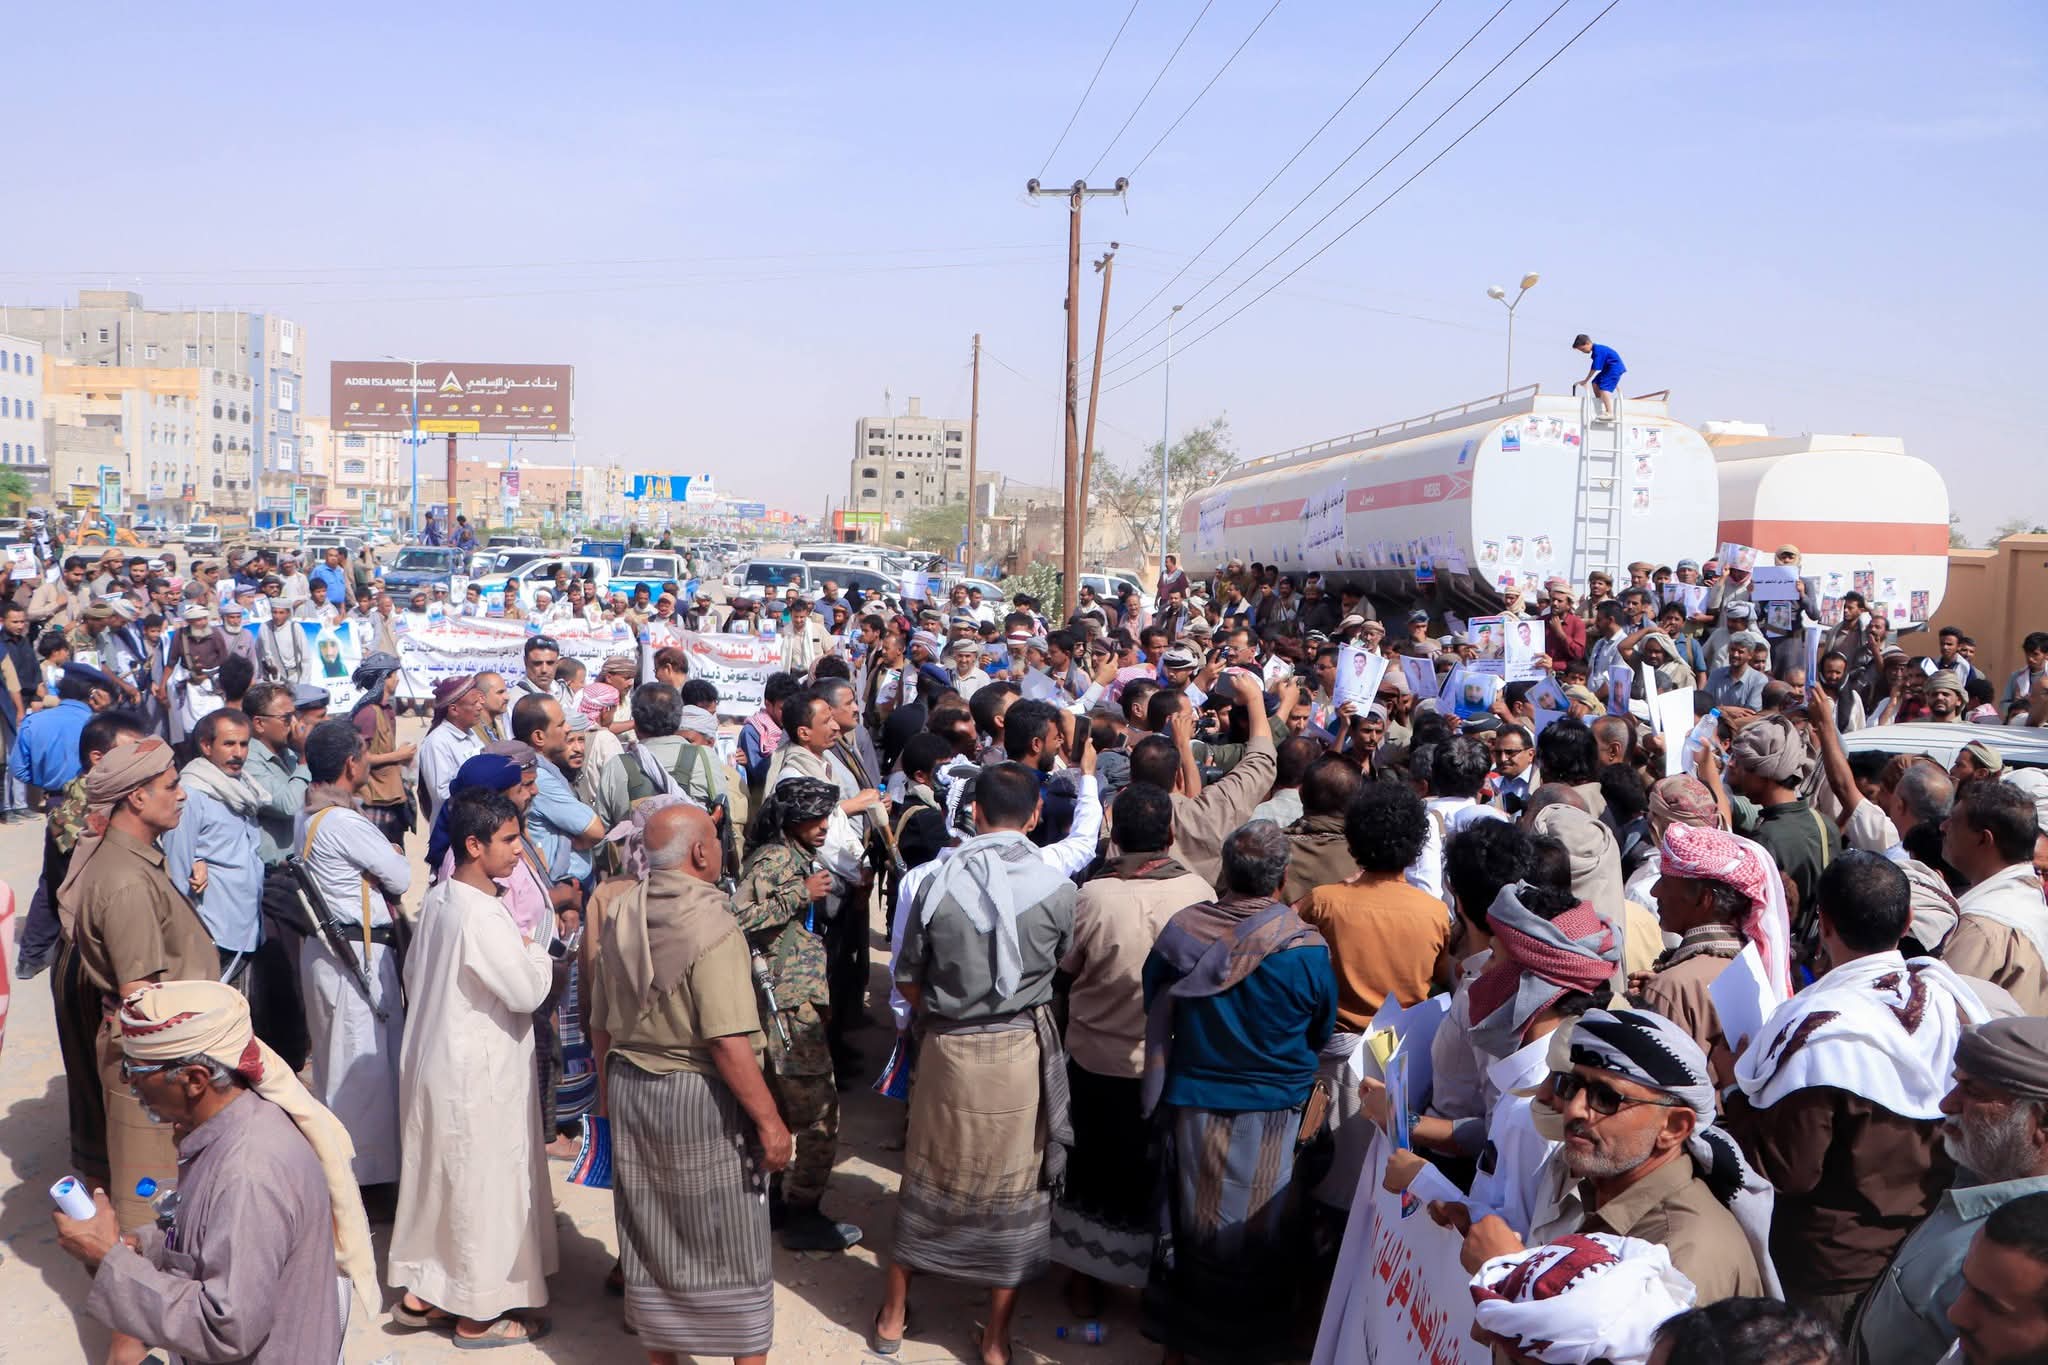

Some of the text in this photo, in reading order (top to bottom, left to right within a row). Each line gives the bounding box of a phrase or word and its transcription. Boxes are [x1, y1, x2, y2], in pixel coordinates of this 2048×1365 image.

[344, 377, 436, 387] ADEN ISLAMIC BANK
[736, 690, 762, 706] وسط
